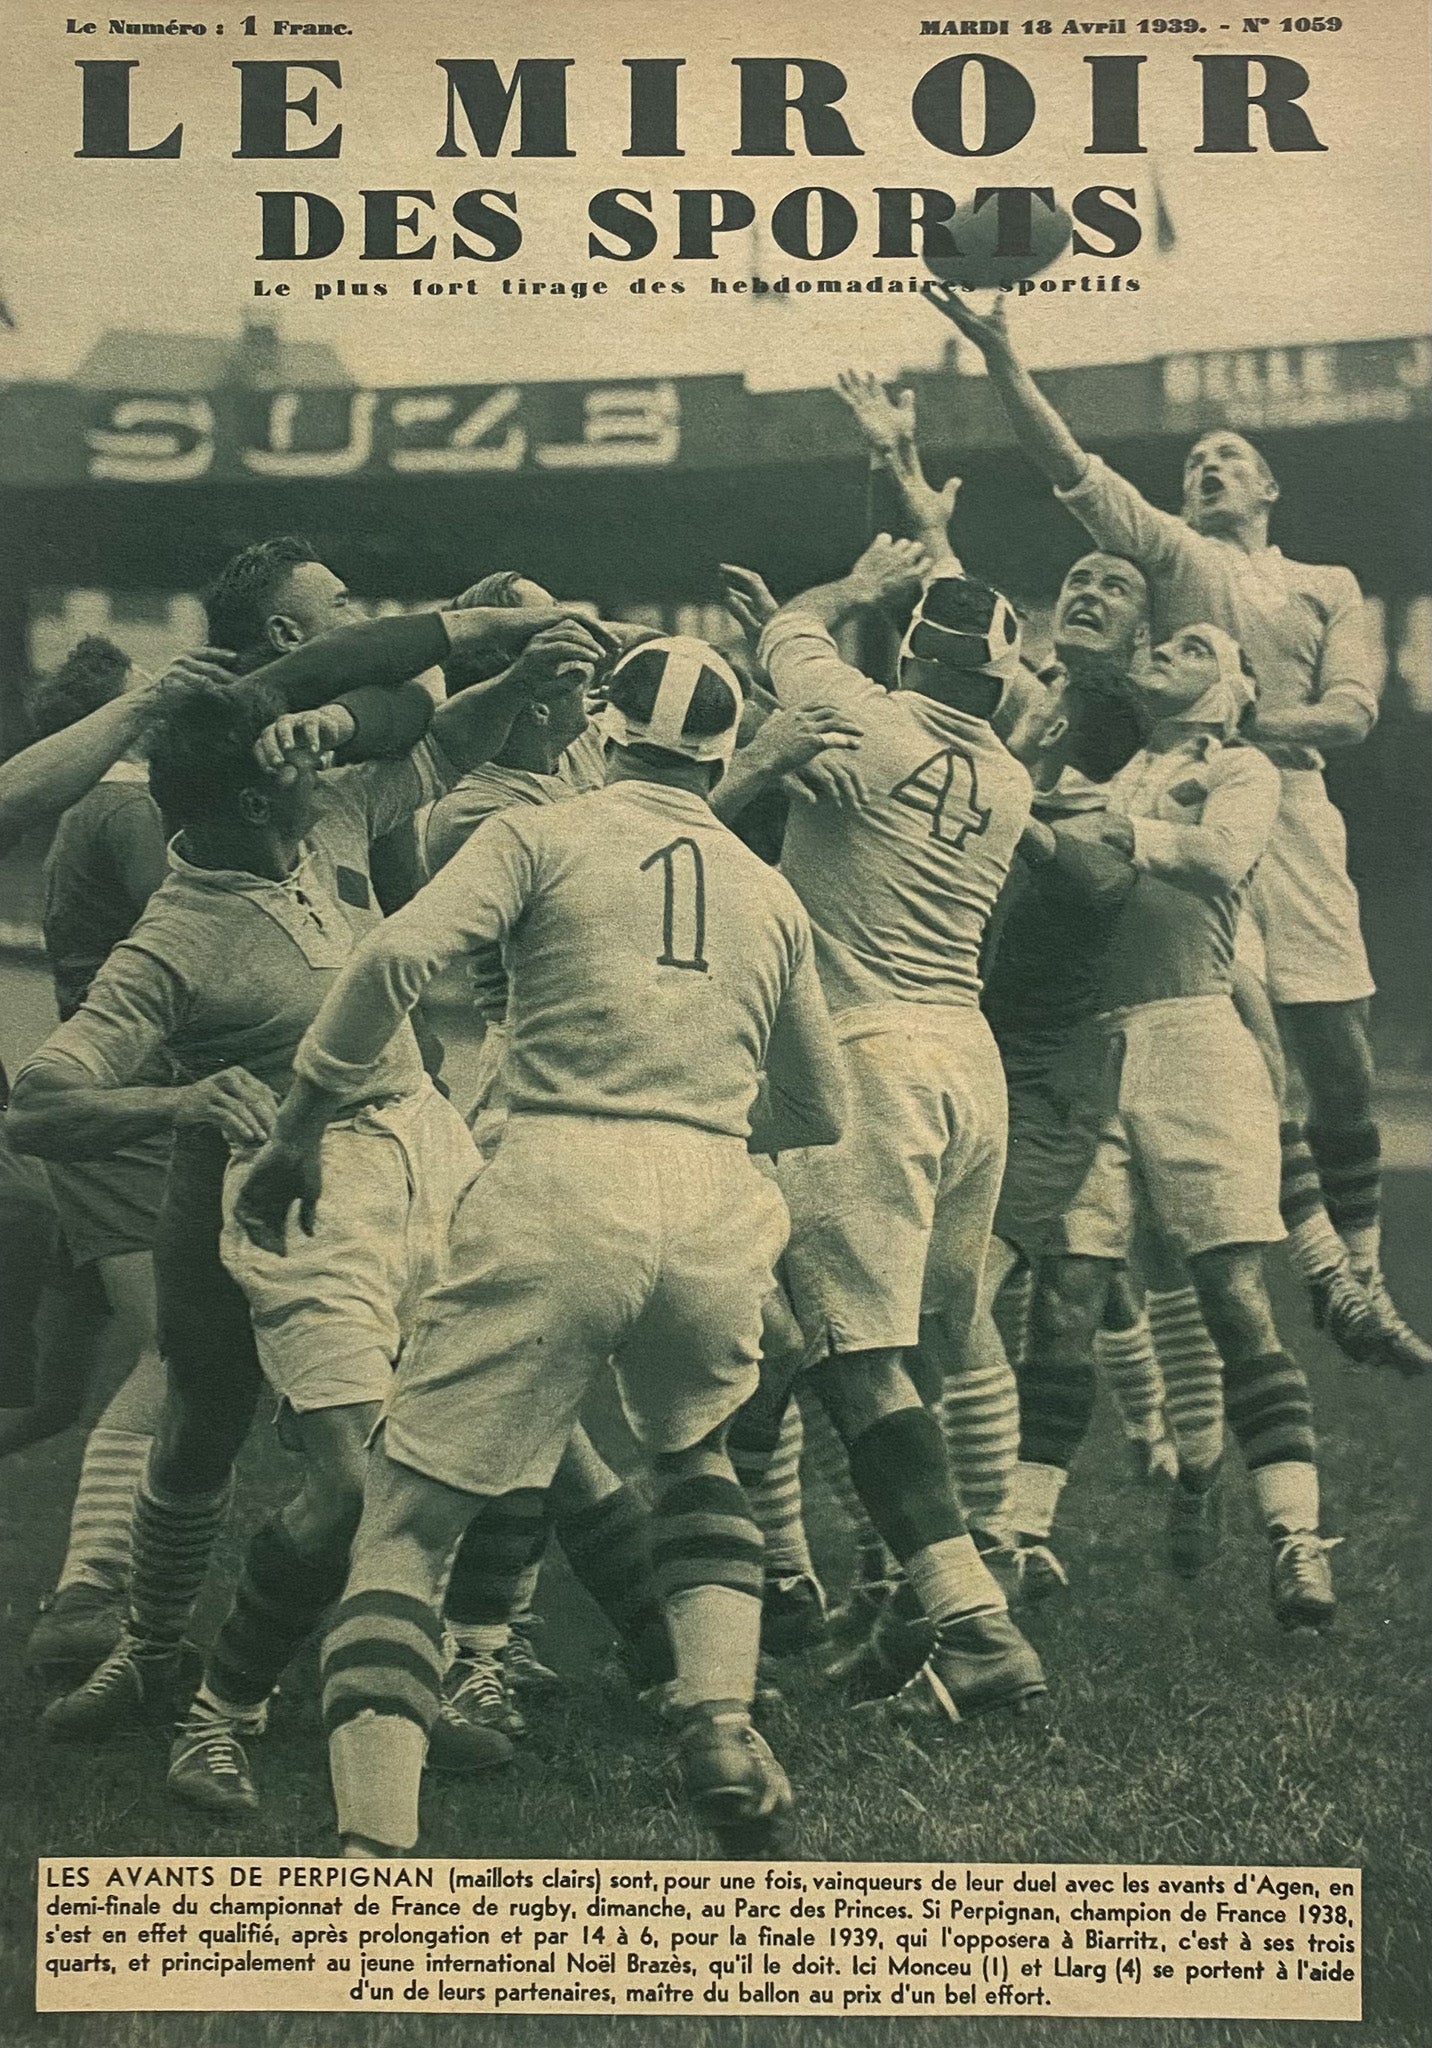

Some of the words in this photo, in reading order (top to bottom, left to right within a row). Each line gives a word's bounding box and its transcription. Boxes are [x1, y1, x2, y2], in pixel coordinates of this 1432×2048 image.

[86, 382, 682, 482] SUZE
[890, 747, 993, 851] 4
[639, 836, 709, 973] 1
